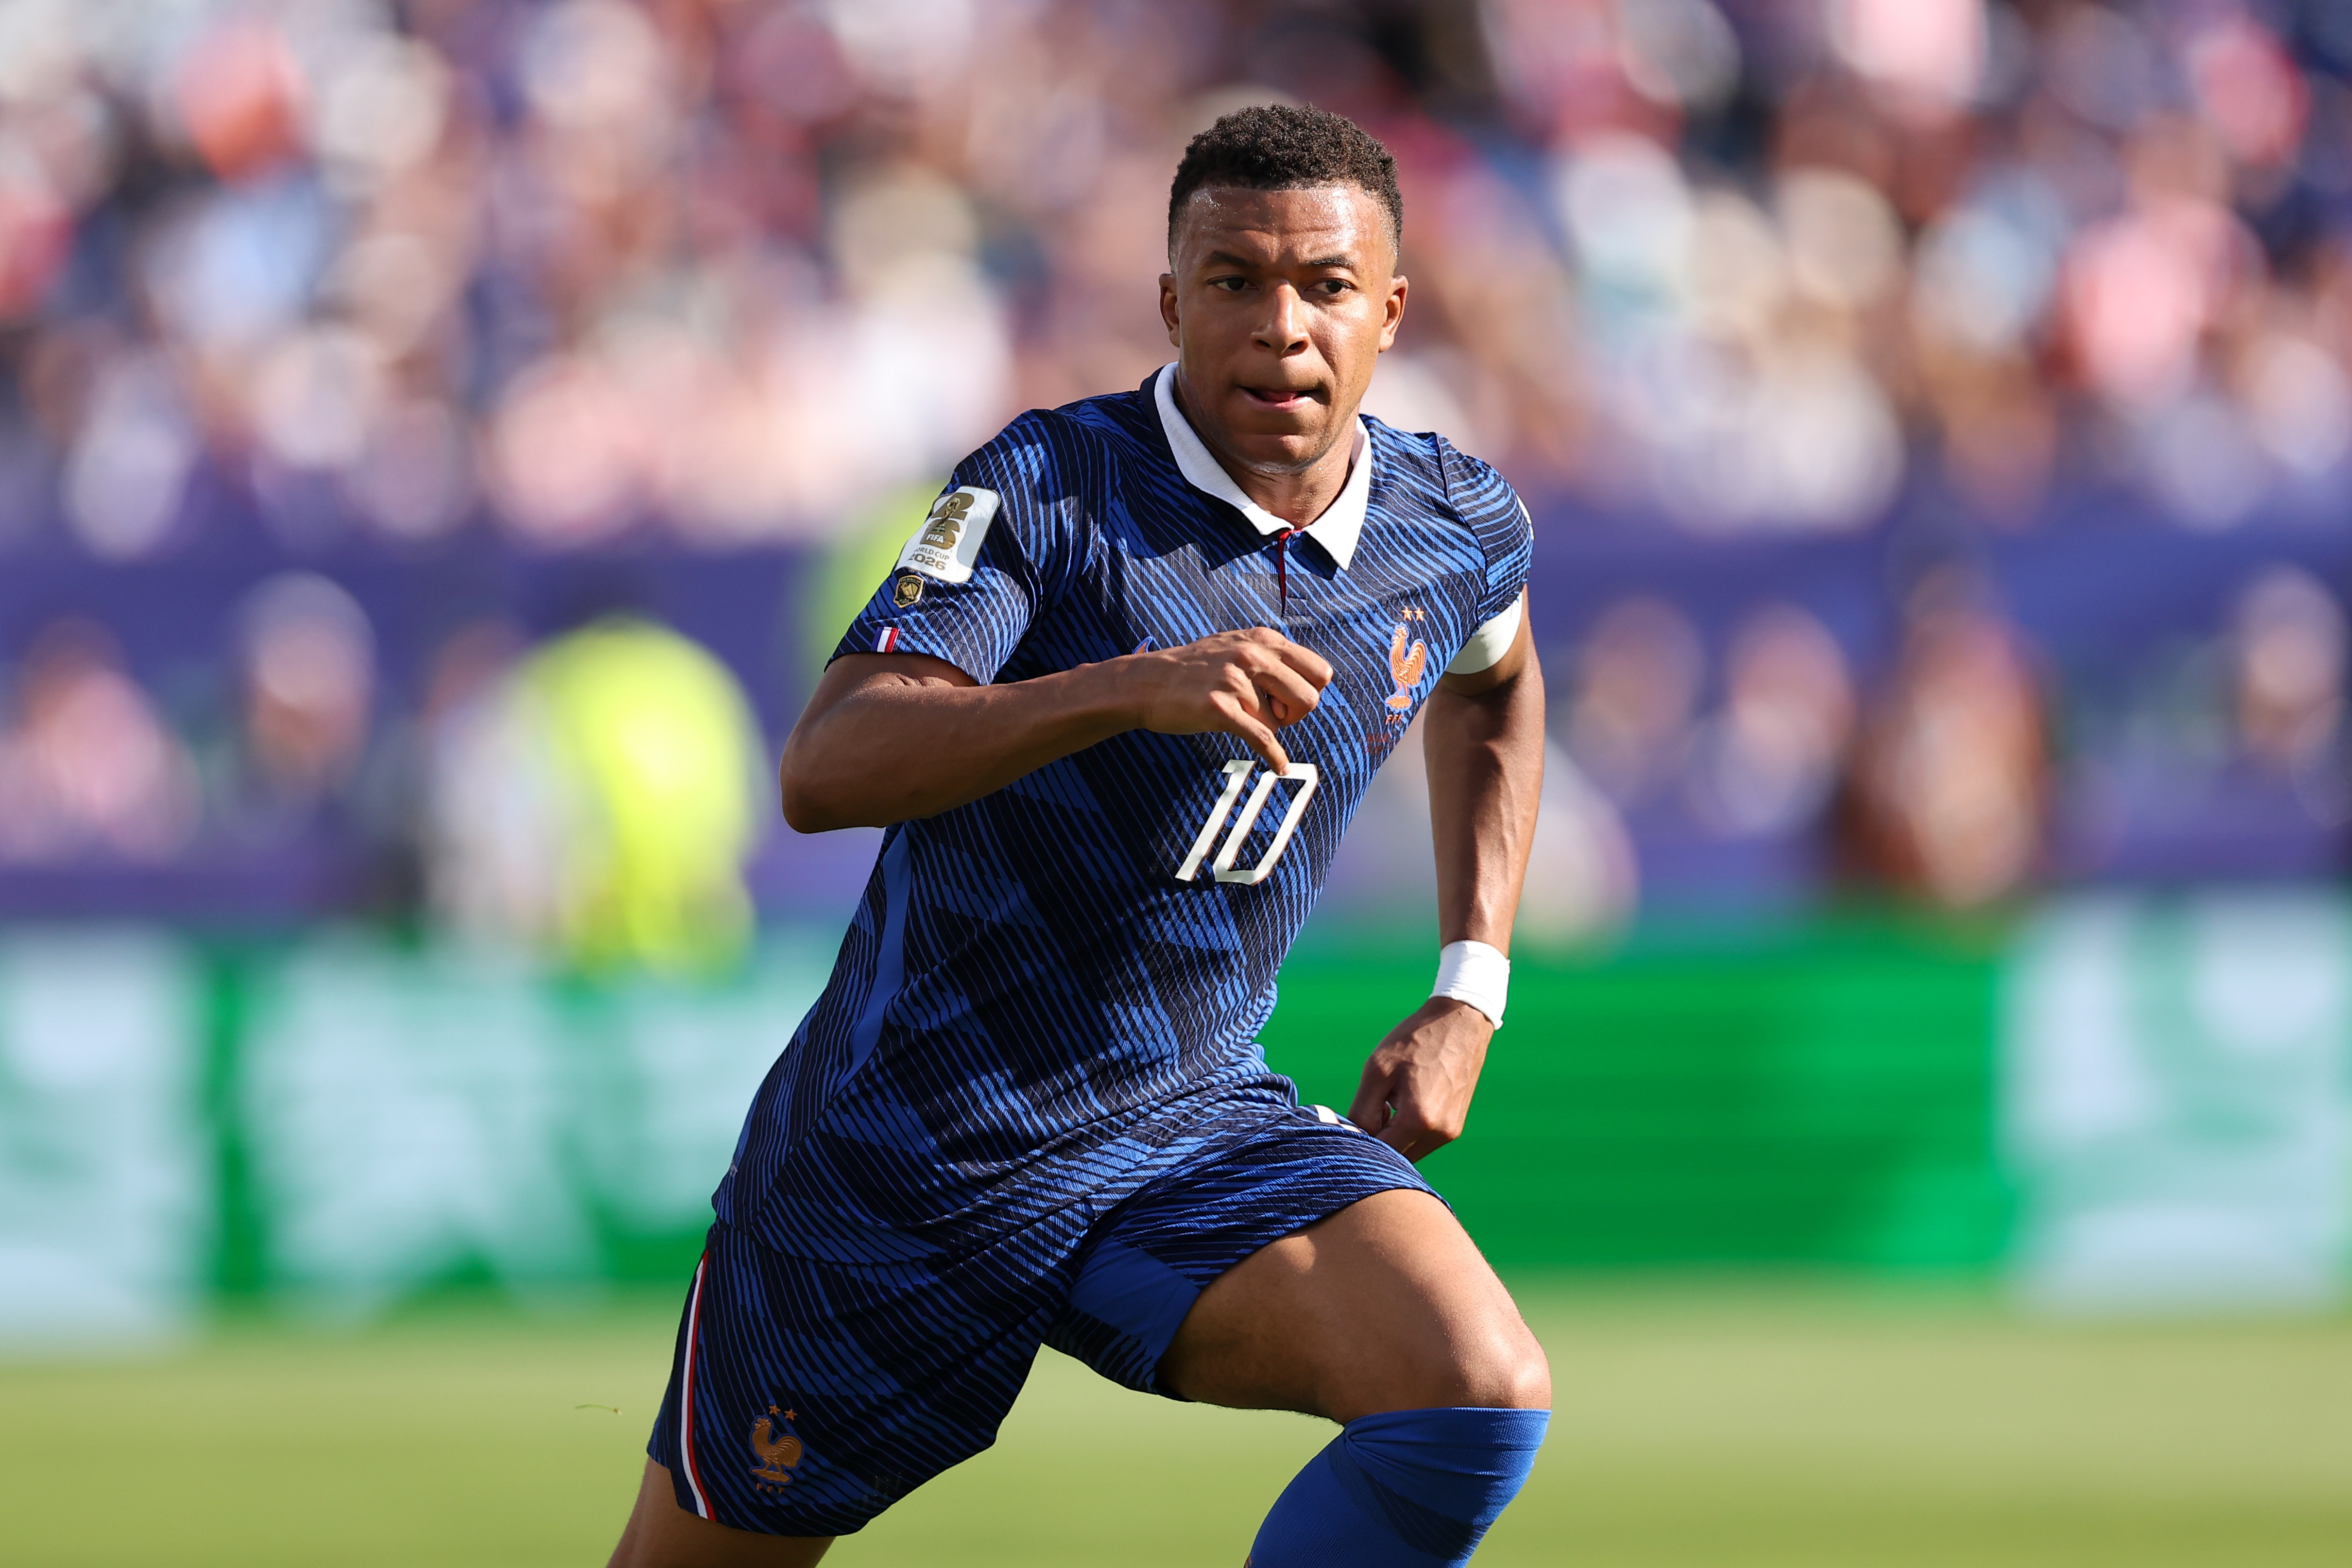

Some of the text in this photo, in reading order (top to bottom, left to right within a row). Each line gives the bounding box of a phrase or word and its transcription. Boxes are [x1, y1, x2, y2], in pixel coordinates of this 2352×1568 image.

[926, 534, 944, 544] FIFA
[907, 553, 947, 571] 2026
[913, 547, 950, 561] ORLD CUP
[1174, 759, 1319, 886] 10
